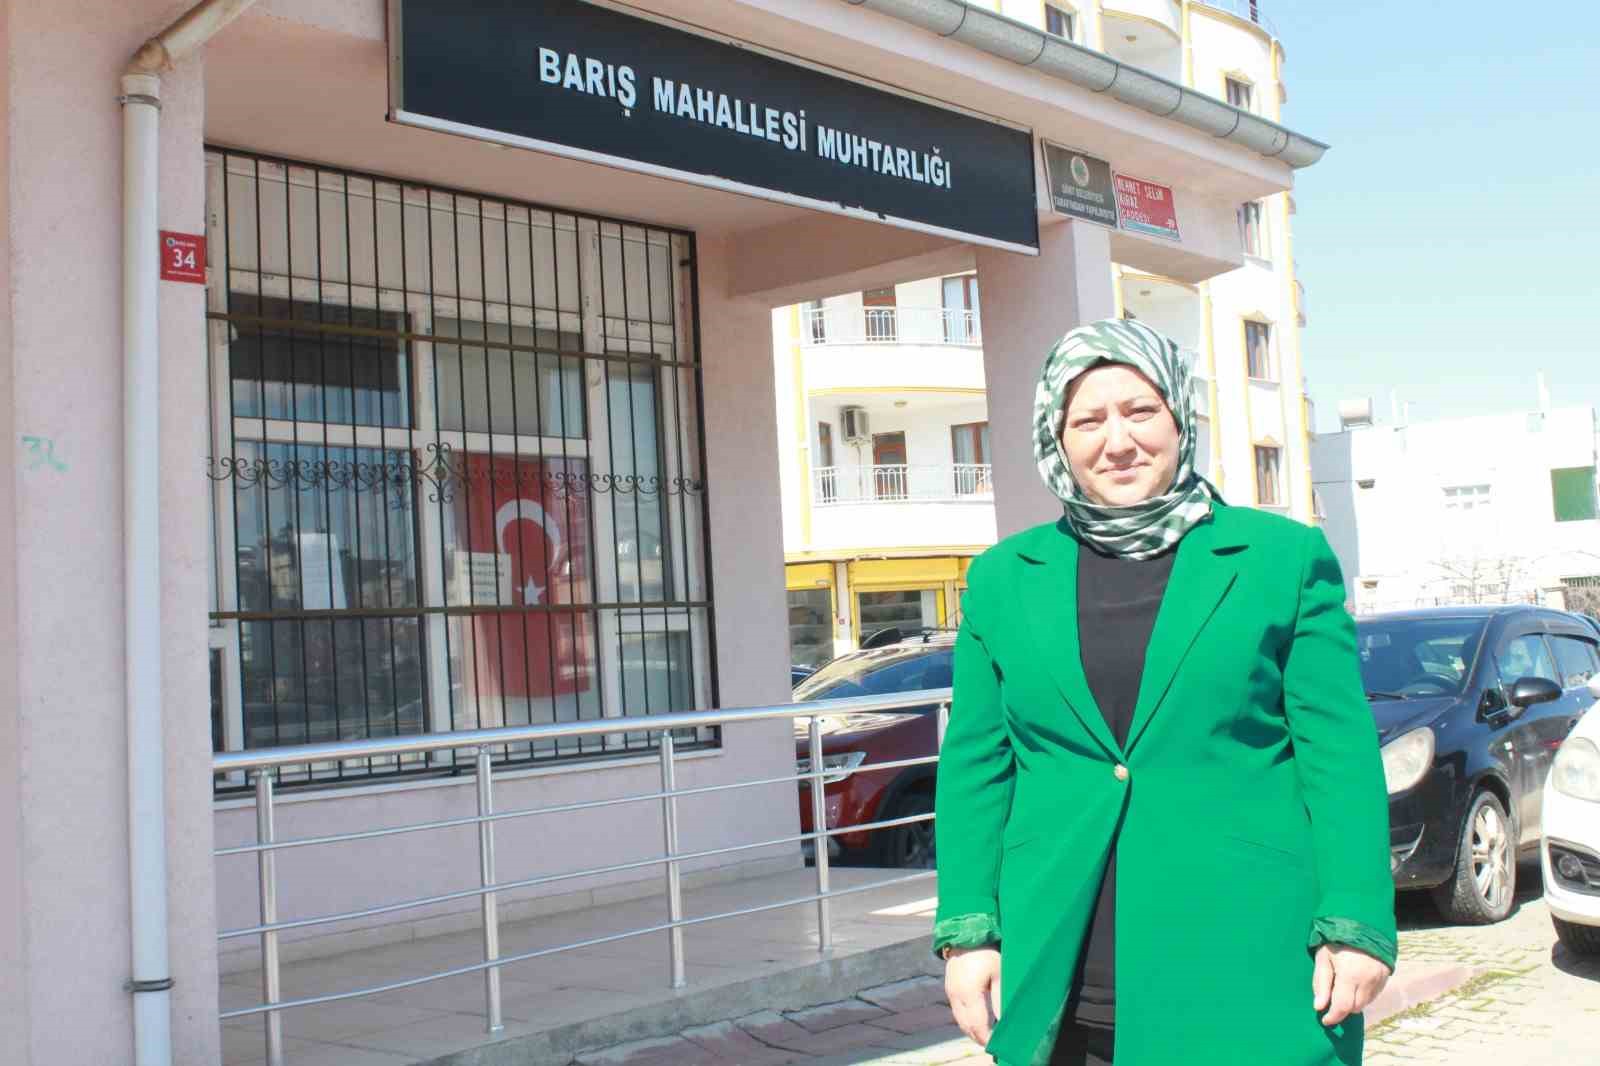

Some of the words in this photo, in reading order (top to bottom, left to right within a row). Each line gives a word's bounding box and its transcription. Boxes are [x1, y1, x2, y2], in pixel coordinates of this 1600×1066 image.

[539, 47, 637, 117] BARIŞ
[652, 76, 807, 152] MAHALLESİ
[817, 125, 952, 189] MUHTARLIĞI
[173, 248, 196, 269] 34
